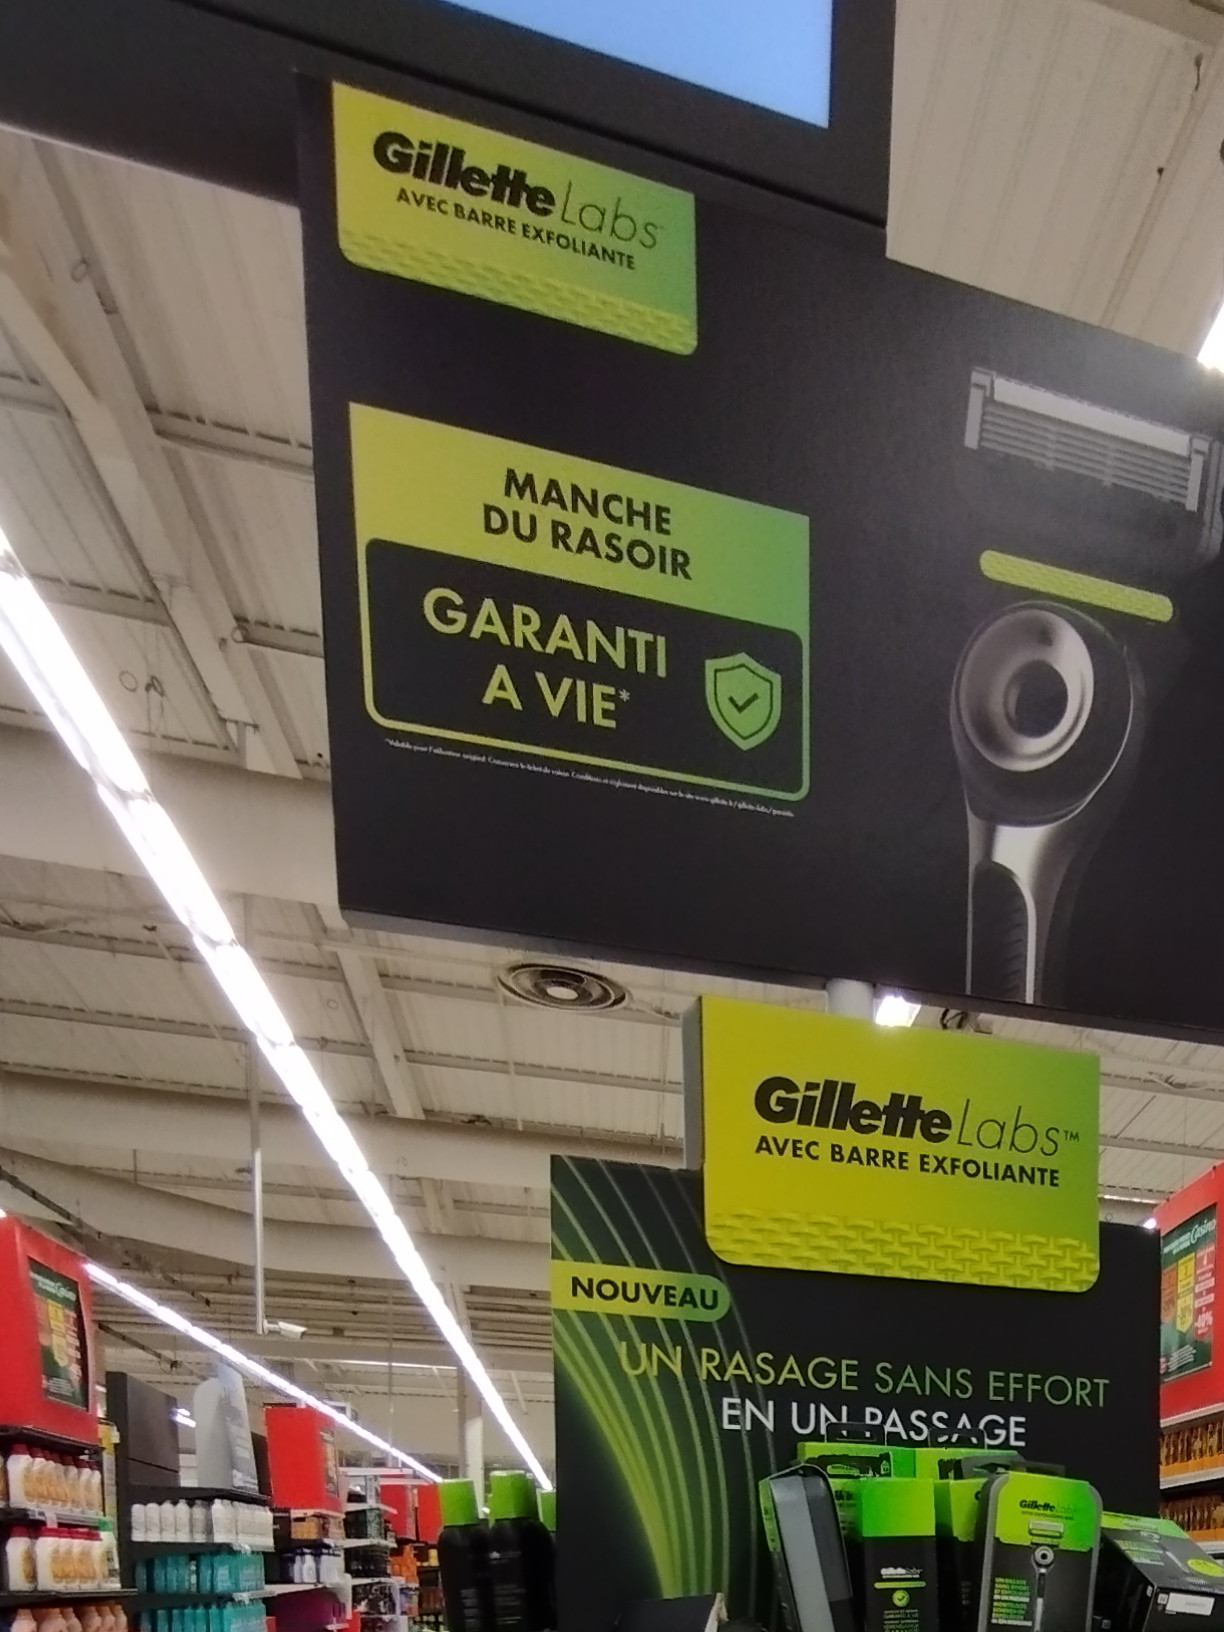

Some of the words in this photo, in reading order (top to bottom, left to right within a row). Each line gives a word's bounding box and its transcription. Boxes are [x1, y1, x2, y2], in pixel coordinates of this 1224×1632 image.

[396, 187, 448, 216] AVEC
[455, 203, 516, 235] BARRE
[522, 222, 635, 270] EXFOLIANTE
[504, 468, 671, 536] MANCHE
[483, 504, 537, 543] DU
[551, 520, 692, 580] RASOIR
[423, 587, 667, 678] GARANTI
[482, 663, 523, 710] A
[755, 1135, 819, 1161] AVEC
[831, 1144, 909, 1171] BARRE
[920, 1155, 1060, 1187] EXFOLIANTE
[571, 1276, 719, 1311] NOUVEAU
[620, 1342, 682, 1378] UN
[701, 1348, 859, 1393] RASAGE
[875, 1361, 973, 1400] SANS
[989, 1371, 1110, 1408] EFFORT
[722, 1397, 774, 1433] EN
[791, 1402, 847, 1436] UN
[865, 1407, 1026, 1447] PASSAGE
